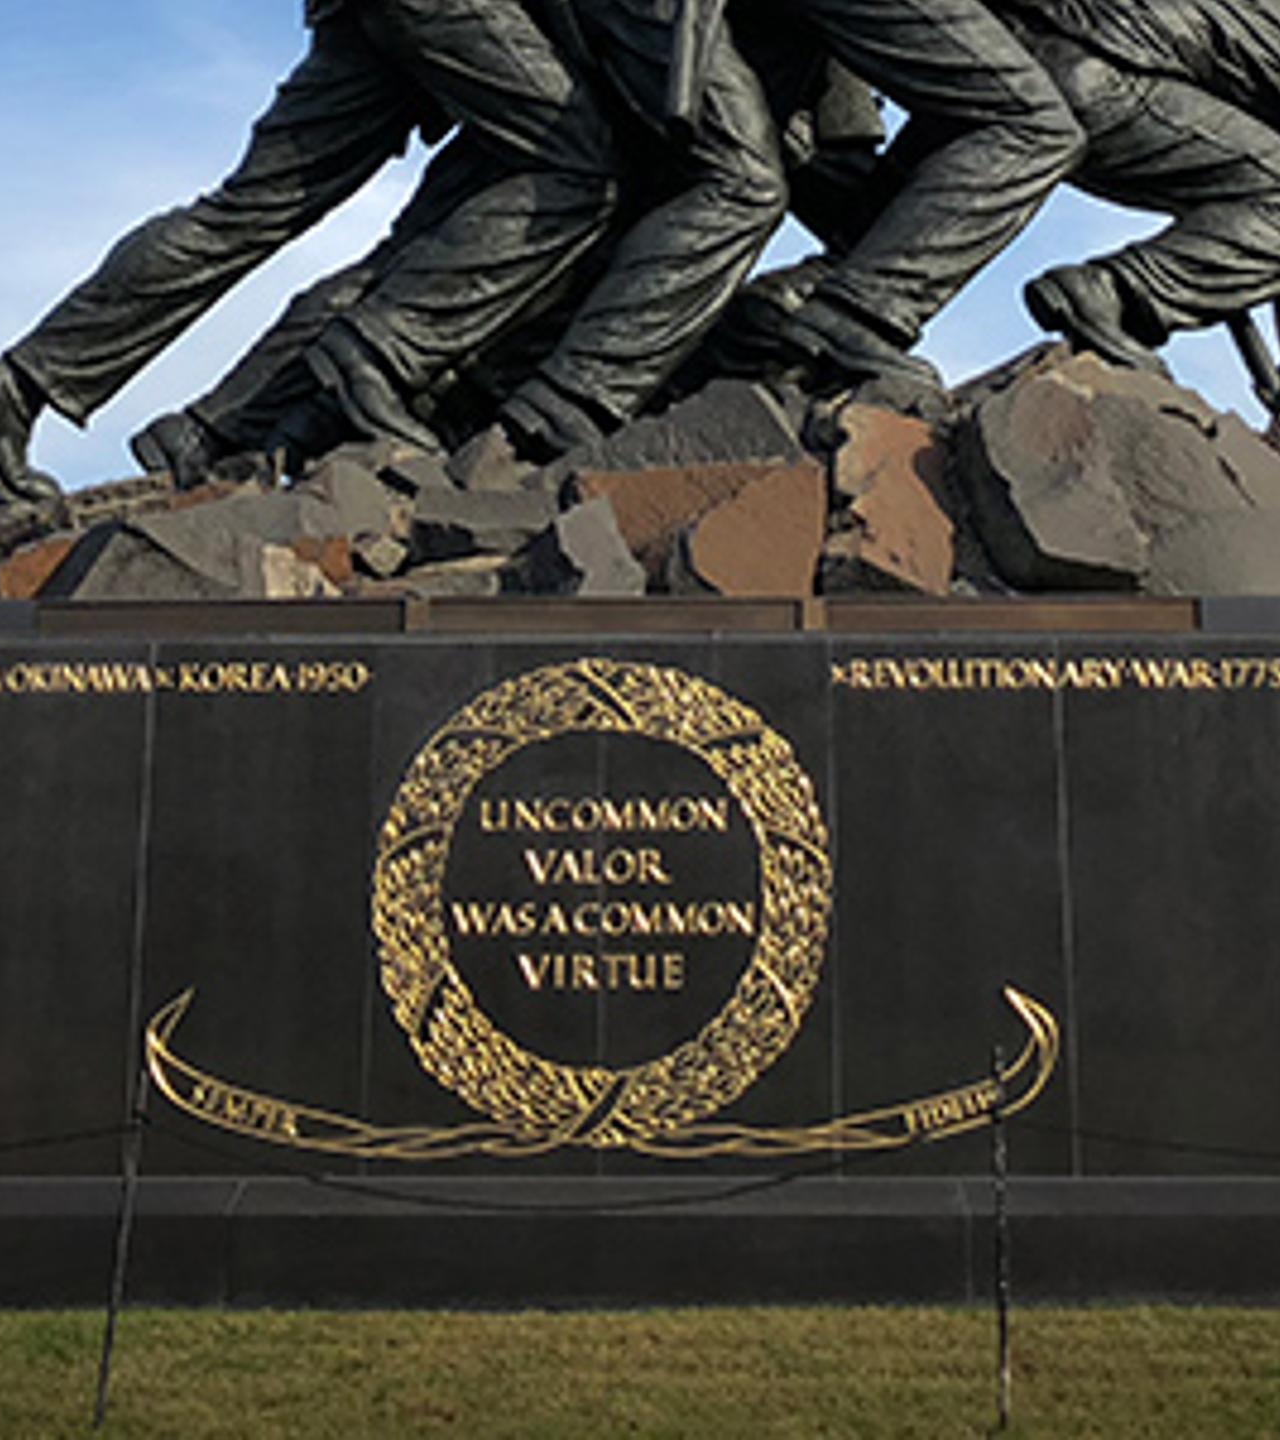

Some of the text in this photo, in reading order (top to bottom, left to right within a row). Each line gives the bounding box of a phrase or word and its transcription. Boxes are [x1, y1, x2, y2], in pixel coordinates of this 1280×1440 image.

[5, 662, 152, 694] OKINAWA
[179, 662, 291, 693] KOREA
[298, 662, 368, 693] 1950
[850, 657, 1125, 690] REVOLUTIONARY
[1130, 657, 1216, 690] WAR
[480, 799, 728, 832] UNCOMMON
[524, 848, 672, 885] VALOR
[451, 901, 756, 936] WAS A COMMON
[518, 954, 685, 991] VIRTUE
